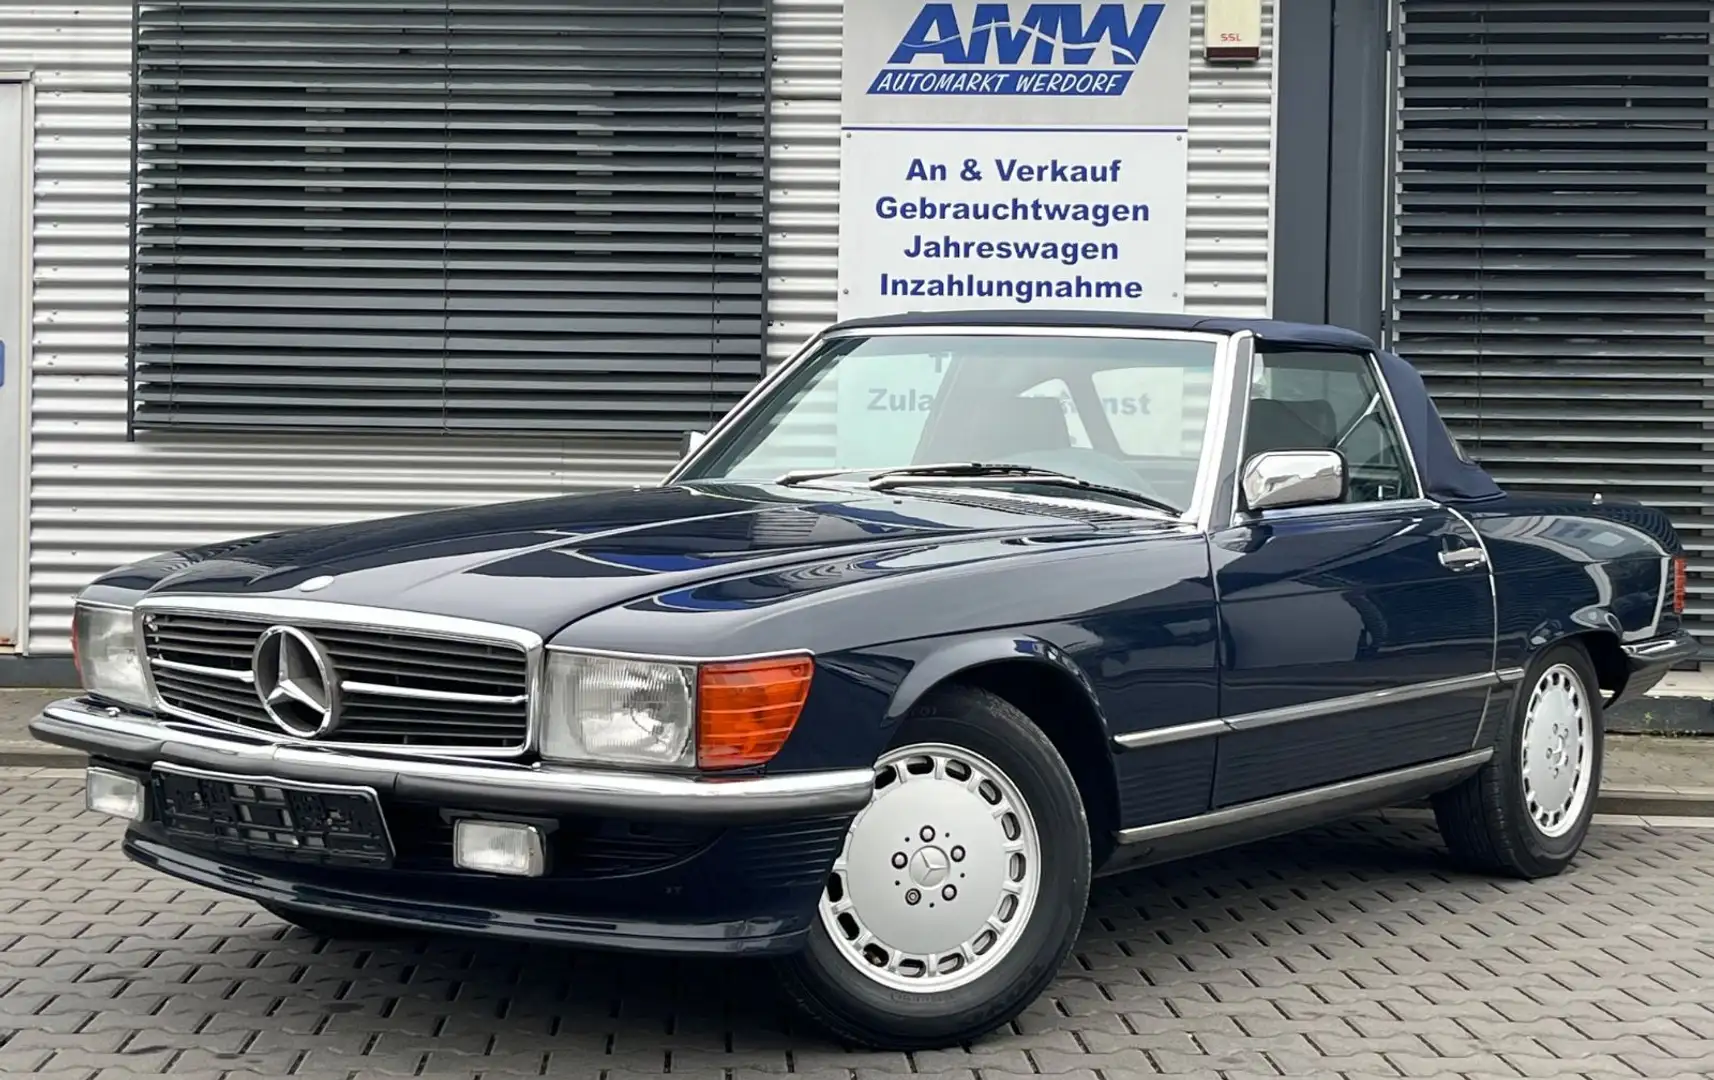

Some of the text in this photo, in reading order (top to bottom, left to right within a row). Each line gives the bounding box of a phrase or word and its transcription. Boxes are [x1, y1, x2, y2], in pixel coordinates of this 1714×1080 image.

[886, 3, 1166, 66] AMW
[876, 72, 1123, 94] AUTOMARKT WERDORF
[905, 158, 1122, 183] An & Verkauf
[875, 196, 1150, 228] Gebrauchtwagen
[903, 235, 1119, 266] Jahreswagen
[880, 273, 1143, 304] Inzahlungnahme
